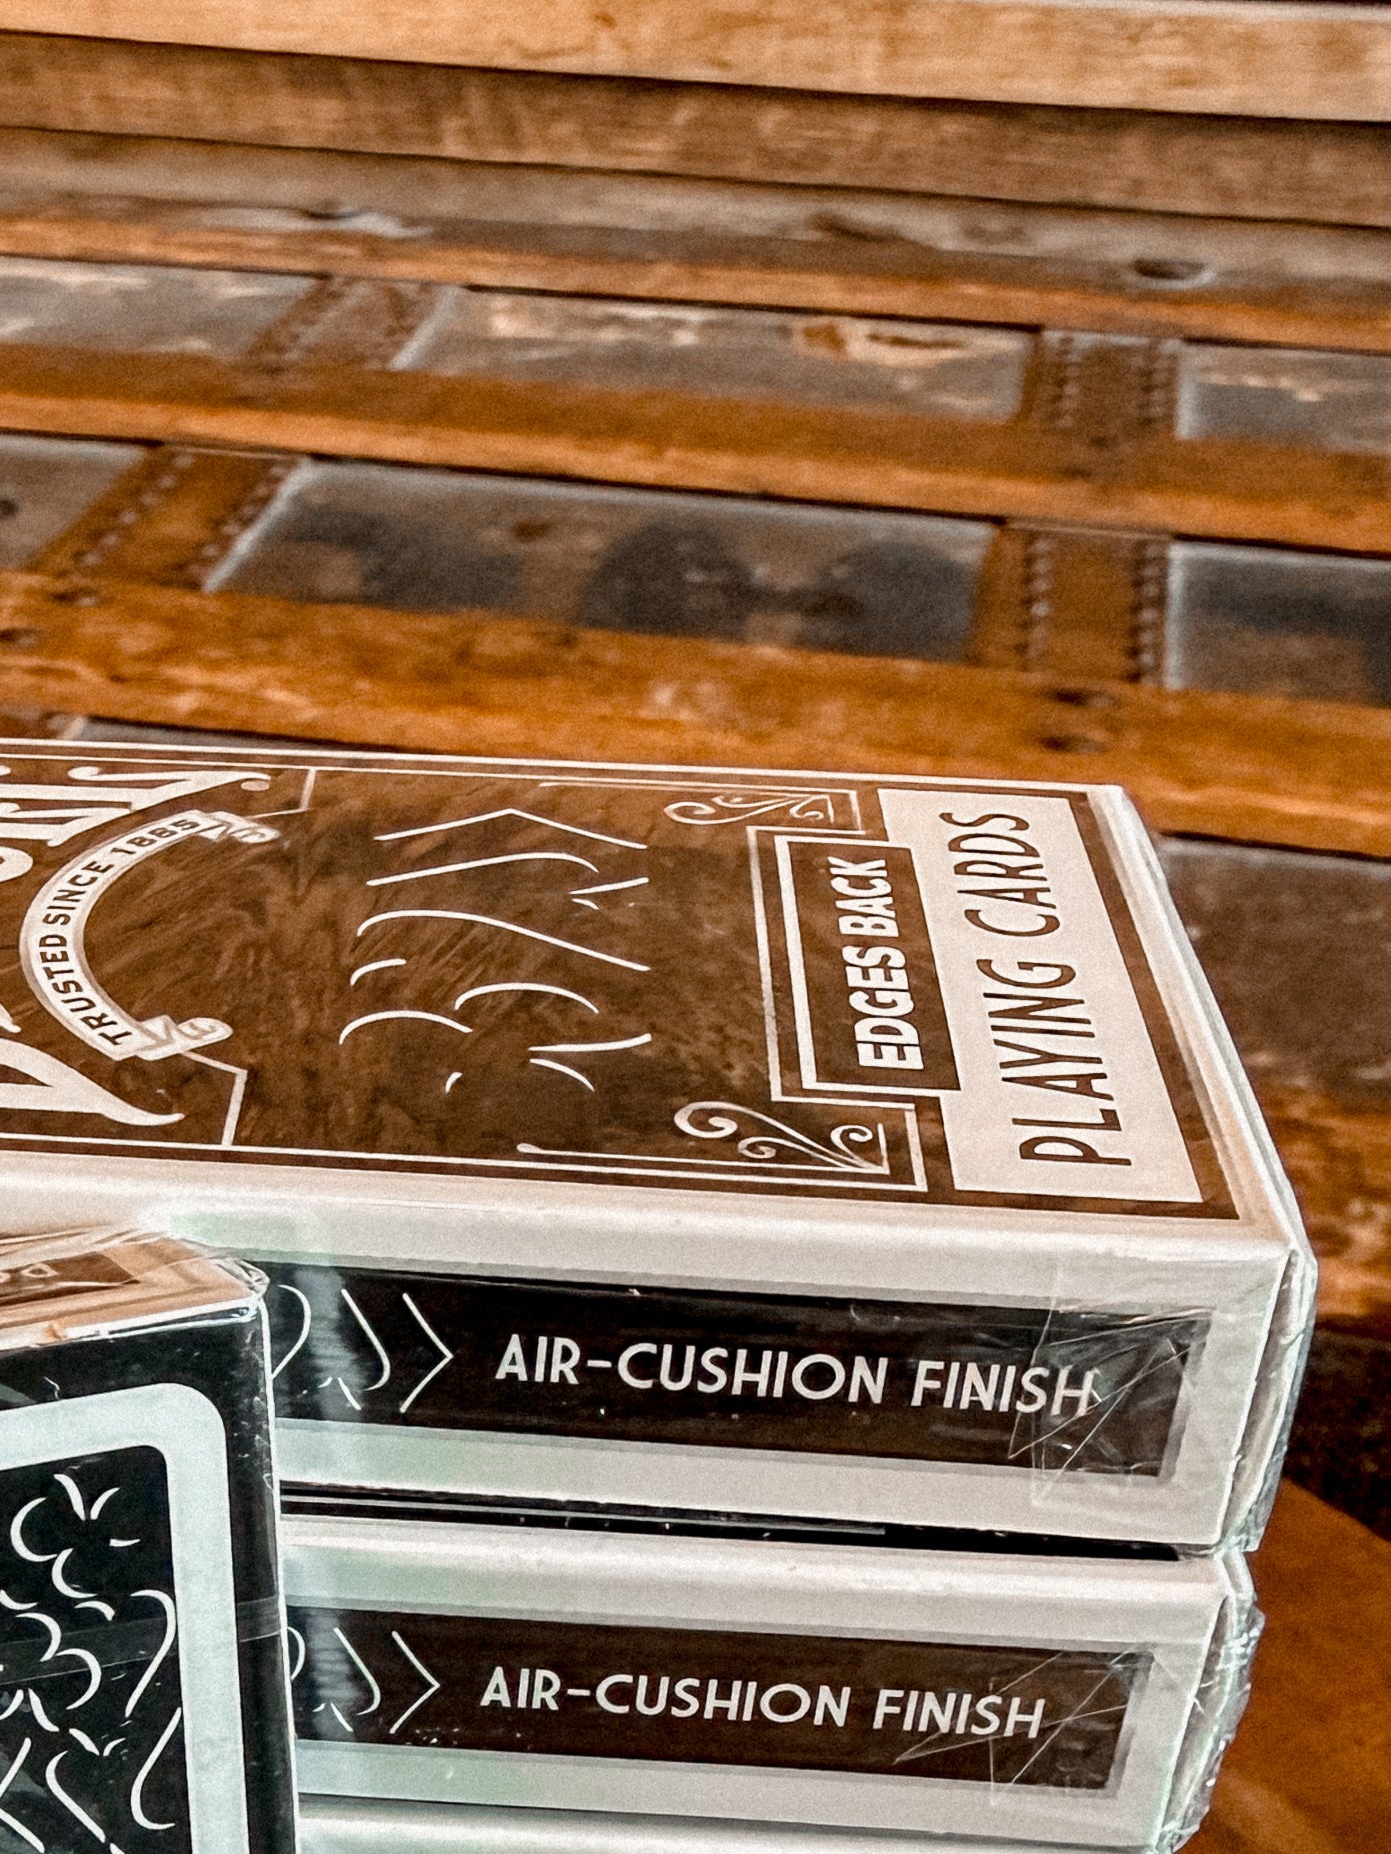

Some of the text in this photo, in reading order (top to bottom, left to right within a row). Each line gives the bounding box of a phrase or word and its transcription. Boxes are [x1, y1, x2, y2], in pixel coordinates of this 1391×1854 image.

[39, 819, 200, 1046] TRUSTED SINCE 1885
[826, 855, 925, 1072] EDGES BACK
[939, 811, 1133, 1167] PLAYING CARDS
[495, 1332, 1094, 1417] AIR-CUSHION FINISH
[480, 1667, 1045, 1739] AIR-CUSHION FINISH
